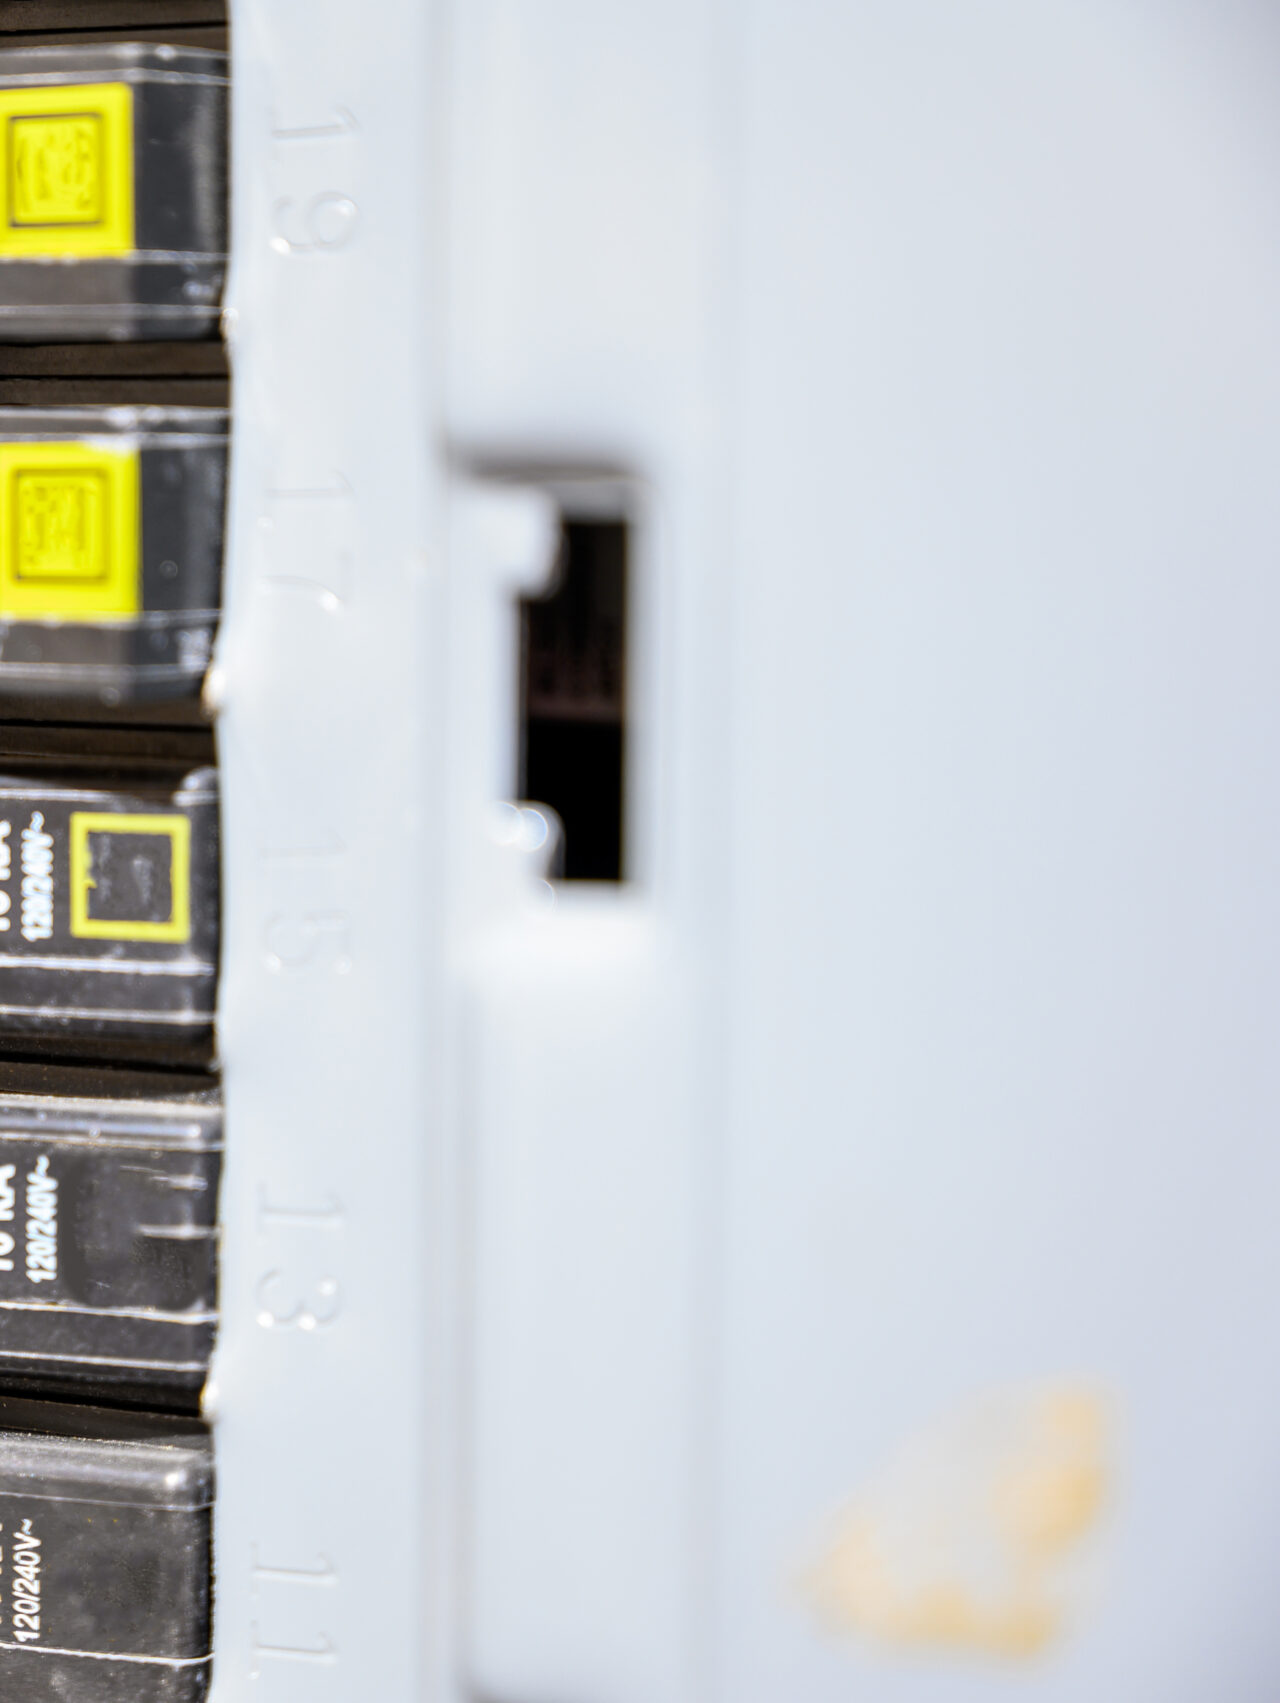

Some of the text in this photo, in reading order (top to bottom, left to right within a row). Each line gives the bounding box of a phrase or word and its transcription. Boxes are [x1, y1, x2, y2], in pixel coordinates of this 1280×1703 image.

[268, 104, 361, 255] 19
[261, 464, 354, 609] 17
[260, 830, 354, 974] 15
[254, 1181, 344, 1331] 13
[250, 1541, 340, 1677] 11
